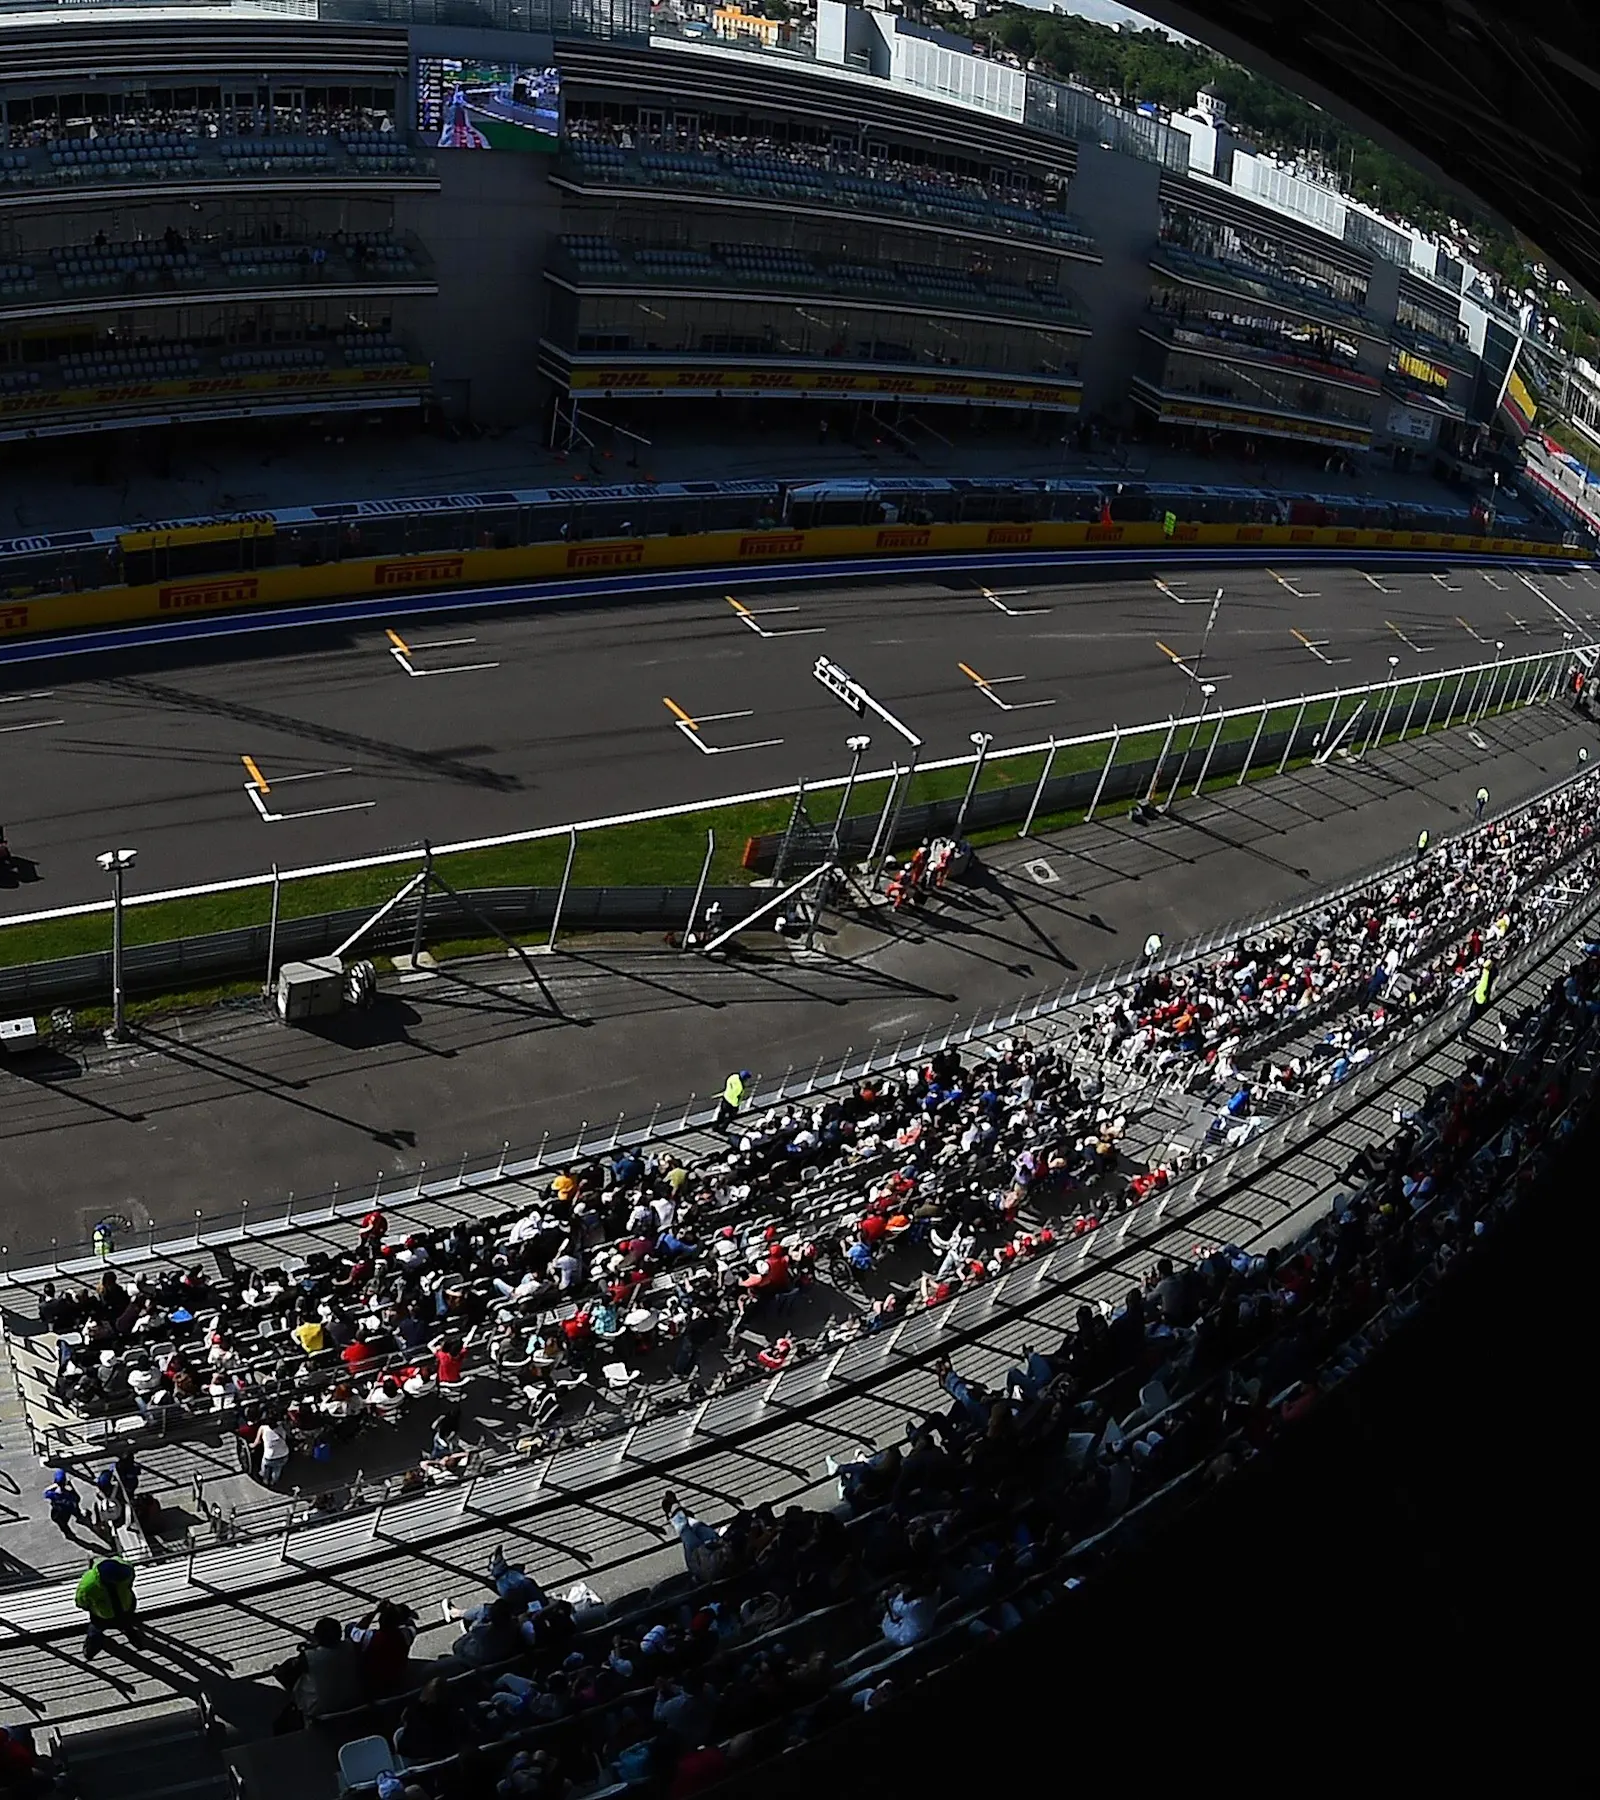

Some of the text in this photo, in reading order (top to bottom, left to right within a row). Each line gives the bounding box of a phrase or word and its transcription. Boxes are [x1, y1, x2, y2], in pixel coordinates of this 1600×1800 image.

[279, 372, 331, 386] DHL
[362, 369, 413, 381] DHL
[598, 373, 650, 386] DHL
[676, 373, 725, 386] DHL
[750, 374, 794, 387] DHL
[816, 375, 856, 388] DHL
[97, 384, 155, 400] DHL
[189, 378, 245, 393] DHL
[878, 379, 916, 392] DHL
[3, 395, 62, 411] DHL
[548, 484, 623, 500] Allianz
[356, 497, 449, 515] Allianz
[739, 535, 804, 556] PIRELLI
[876, 530, 930, 548] PIRELLI
[567, 545, 643, 567] PIRELLI
[375, 558, 463, 584] PIRELLI
[159, 579, 258, 609] PIRELLI
